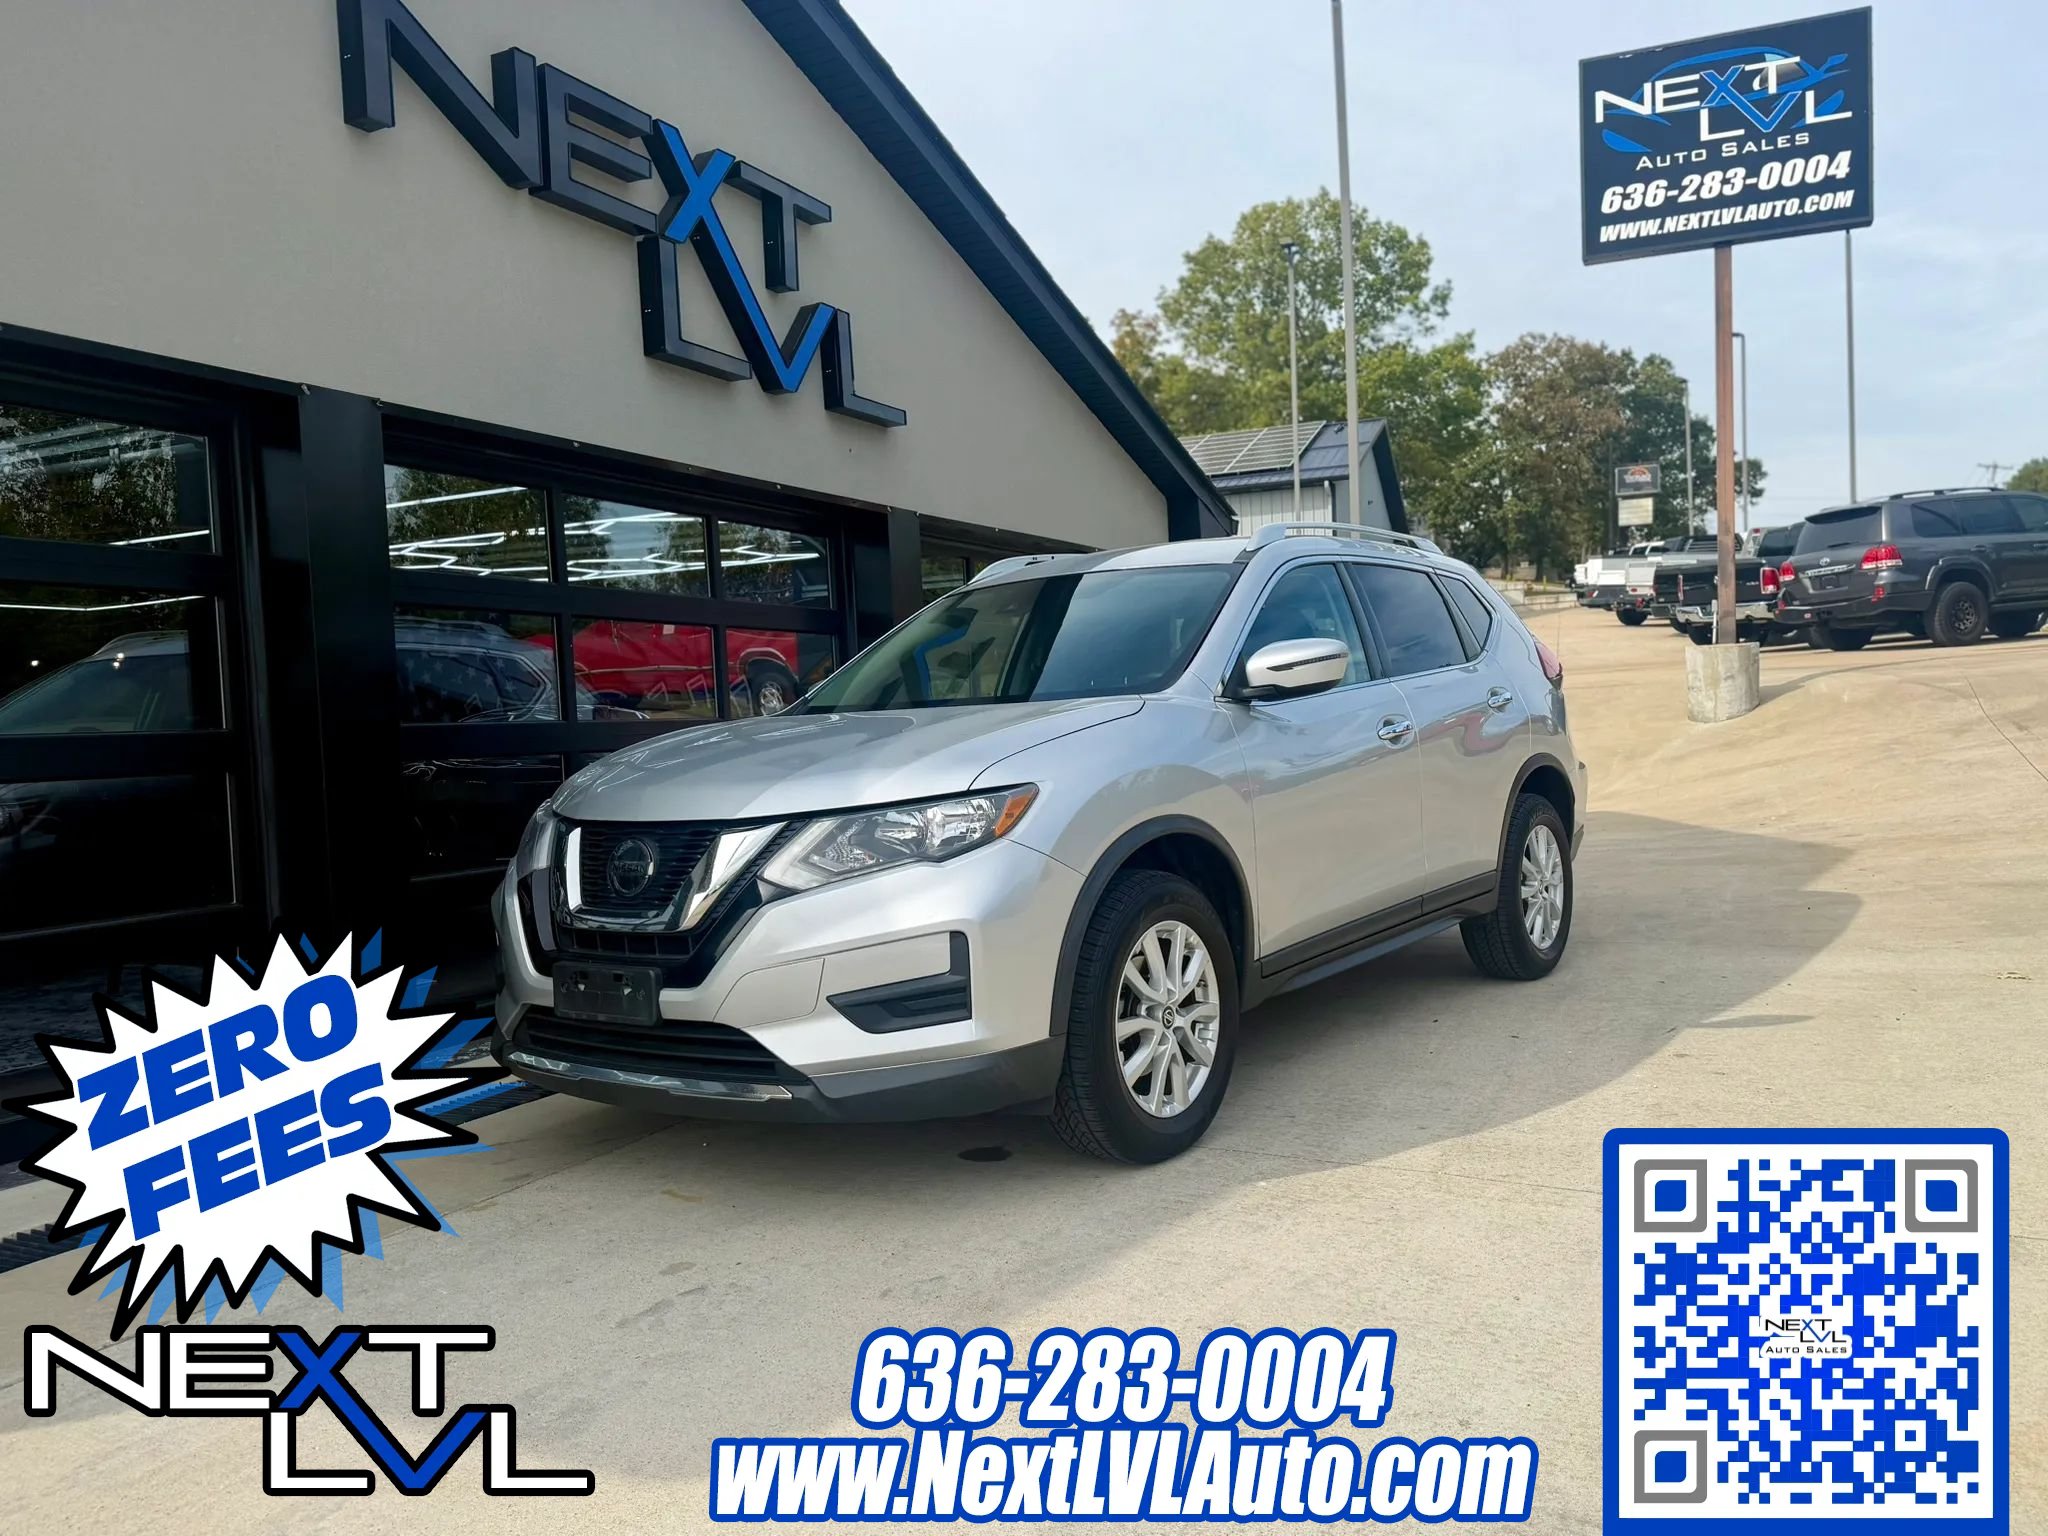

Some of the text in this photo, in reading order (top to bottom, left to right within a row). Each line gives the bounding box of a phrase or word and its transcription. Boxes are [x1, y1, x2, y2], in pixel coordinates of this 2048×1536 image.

[1595, 55, 1801, 124] NEXT
[1700, 89, 1853, 142] LVL
[337, 0, 832, 293] NEXT
[1600, 150, 1853, 214] 636-283-0004
[1599, 189, 1855, 243] WWW.NEXTLVLAUTO.COM
[637, 235, 907, 428] LVL
